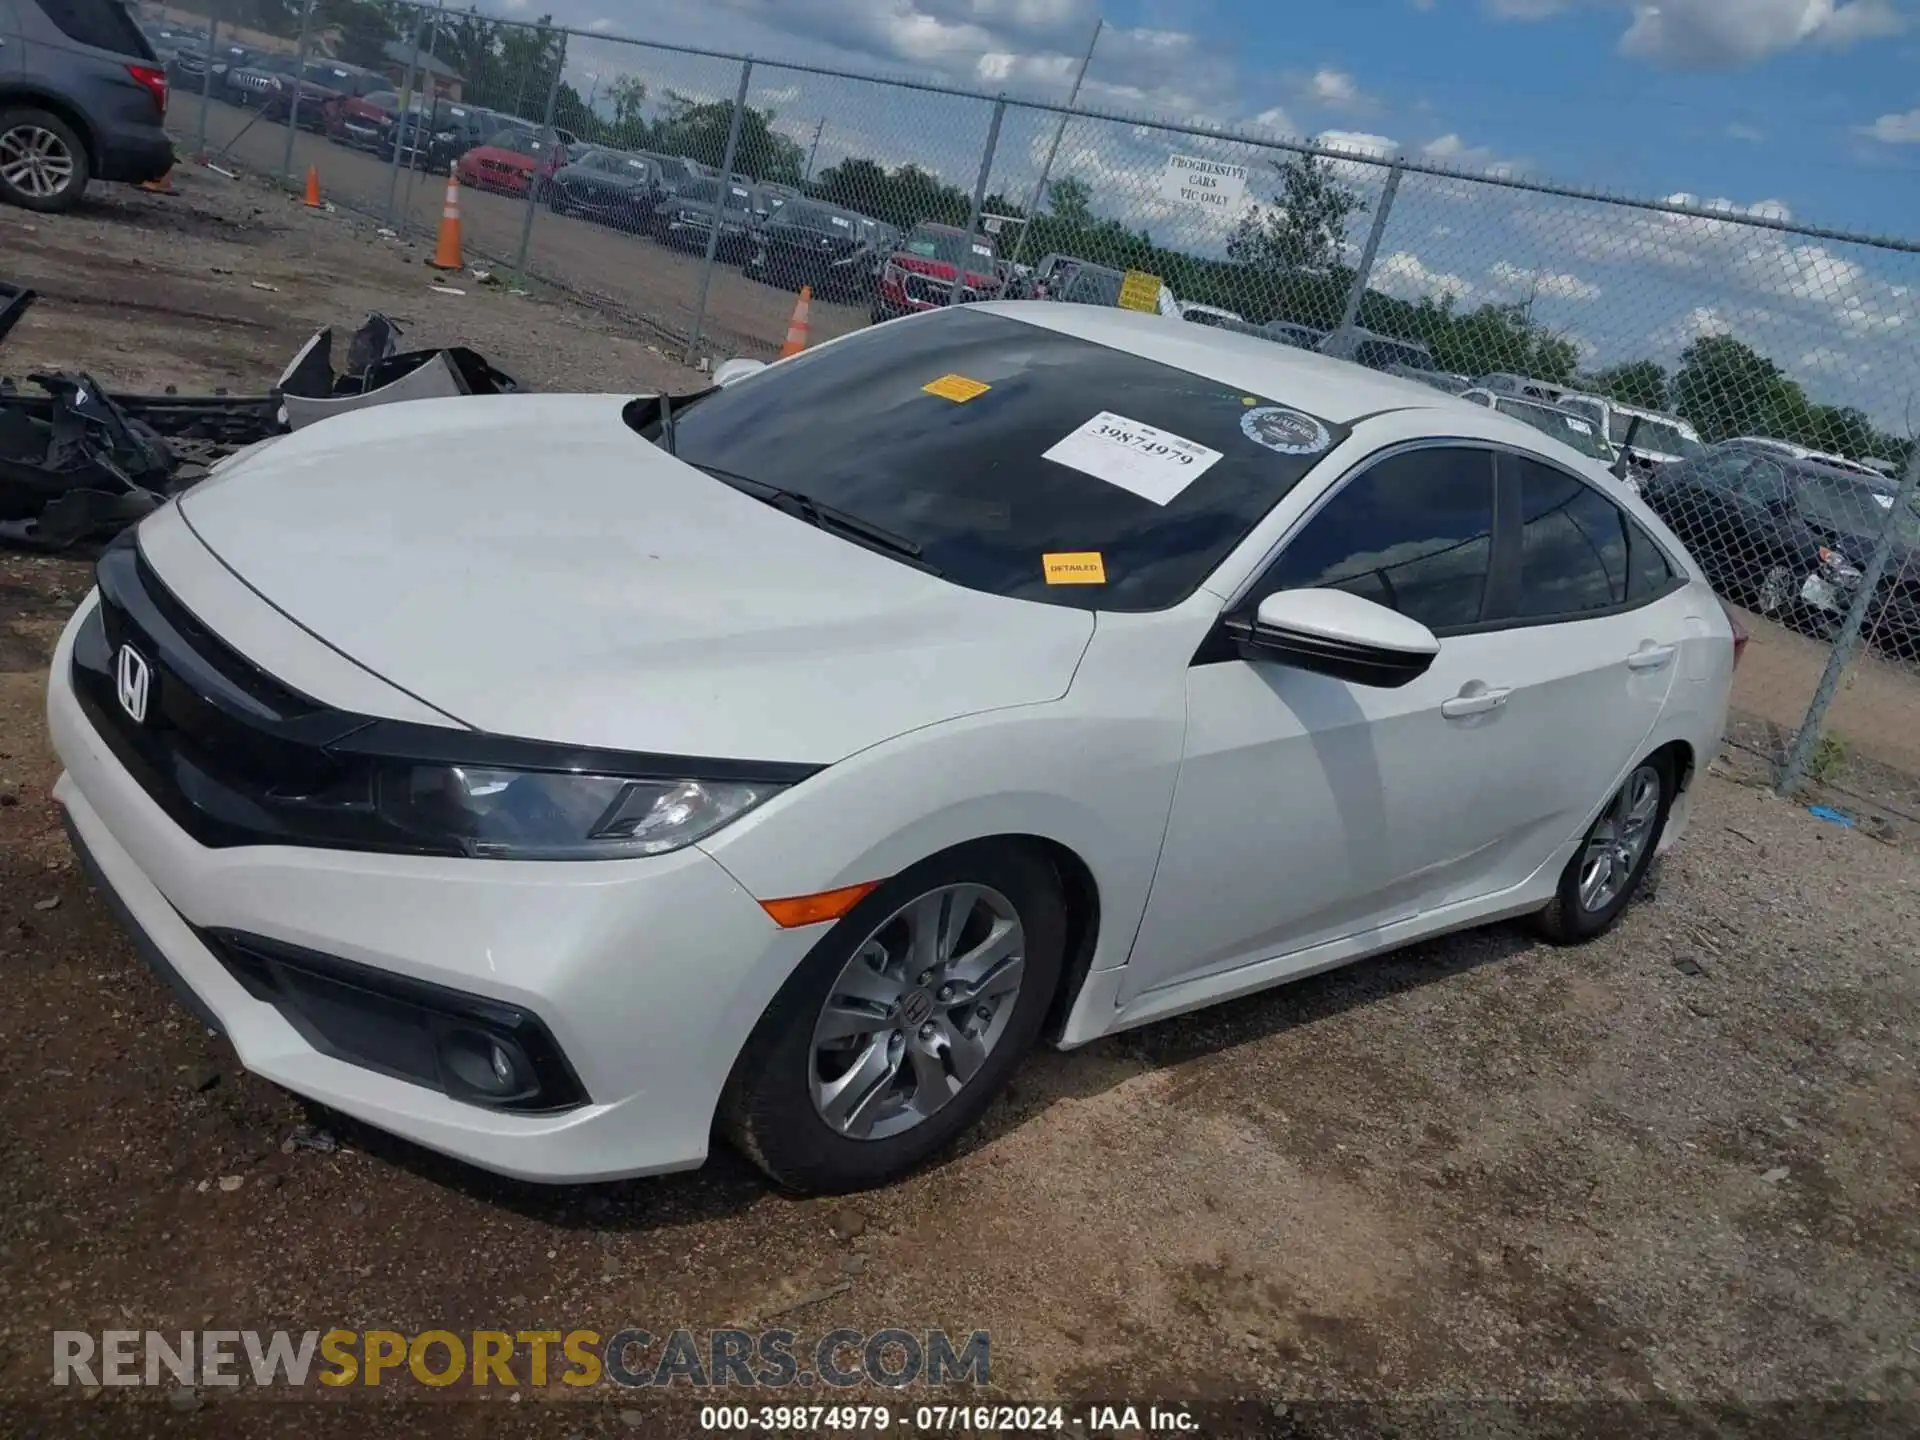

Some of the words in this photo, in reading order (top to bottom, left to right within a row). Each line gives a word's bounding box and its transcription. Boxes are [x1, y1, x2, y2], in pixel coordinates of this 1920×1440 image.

[1170, 156, 1247, 180] PROGRESSIVE
[1188, 174, 1217, 188] CARS
[1200, 192, 1229, 206] ONLY
[1092, 424, 1195, 466] 39874979
